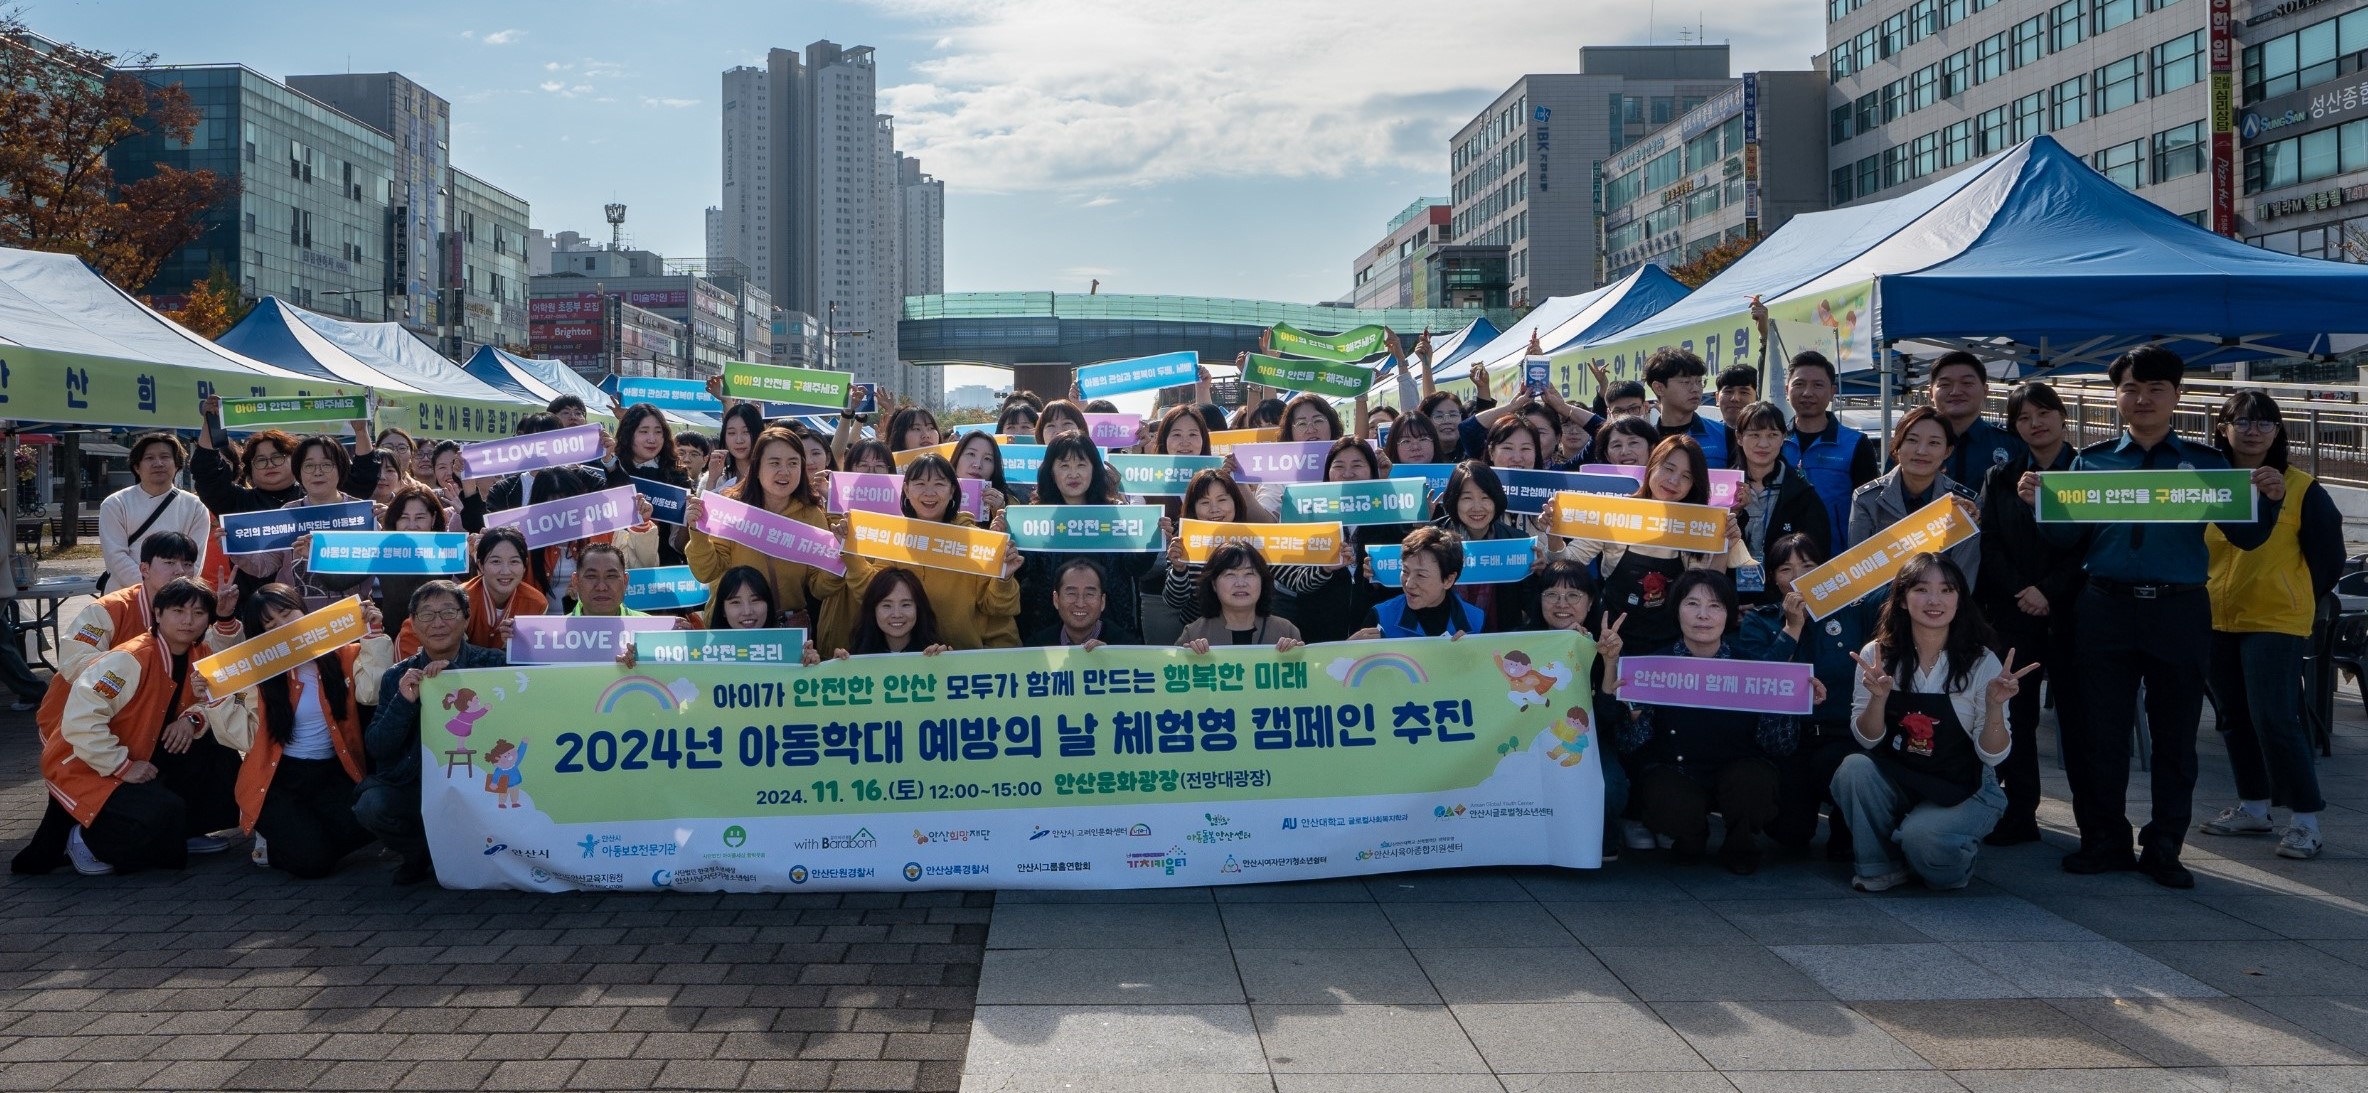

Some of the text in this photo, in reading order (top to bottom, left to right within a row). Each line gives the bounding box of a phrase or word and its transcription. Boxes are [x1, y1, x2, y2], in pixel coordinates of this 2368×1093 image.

[2216, 91, 2229, 131] 심리상담
[1537, 127, 1549, 192] IBK 기업은행
[2217, 157, 2230, 187] Pizza
[2218, 188, 2229, 211] Hut
[558, 302, 581, 312] 초등부
[584, 302, 600, 312] 모집
[554, 327, 582, 338] Brighton
[733, 374, 840, 396] 아이의 안전을 구해주세요
[1084, 376, 1107, 388] 아동의
[1108, 372, 1131, 385] 관심과
[1132, 367, 1156, 381] 행복이
[1257, 365, 1362, 388] 아이의 안전을 구해주세요
[235, 399, 355, 414] 아이의 안전을 구해주세요
[419, 402, 518, 437] 안산시육아종합지
[1097, 424, 1130, 438] 지켜요
[482, 435, 585, 465] I LOVE 아이
[1252, 453, 1319, 471] I LOVE
[843, 487, 895, 504] 안산아이
[1501, 485, 1519, 496] 리의
[2057, 488, 2233, 504] 아이의 안전을 구해주세요
[652, 495, 678, 509] 아동보호
[235, 516, 365, 539] 우리의 관심에서 시작되는 아동보호
[527, 501, 618, 536] LOVE 아이
[1022, 518, 1144, 537] 아이+안전=권리
[1561, 507, 1717, 537] 행복의 아이를 그리는 안산
[709, 508, 839, 559] 안산아이 함께 지켜요
[854, 525, 997, 562] 행복의 아이를 그리는 안산
[1189, 535, 1226, 549] 행복의
[1269, 536, 1304, 550] 그리는
[1307, 538, 1333, 551] 안산
[320, 546, 349, 559] 아동의
[351, 546, 380, 559] 관심과
[383, 547, 412, 559] 행복이
[1507, 554, 1527, 566] 세배
[1811, 514, 1956, 601] 행복의 아이를 그리는 안산
[626, 582, 645, 596] 심과
[648, 581, 675, 594] 행복이
[212, 613, 355, 683] 행복의 아이를 그리는 안산
[534, 631, 545, 649] I
[552, 630, 612, 650] LOVE
[654, 643, 783, 663] 아이+안전=권리
[713, 662, 1308, 709] 아이가 안전한 안산 모두가 함께 만드는 행복한 미래
[1634, 670, 1794, 696] 안산아이 함께 지켜요
[555, 699, 1476, 773] 2024년 아동학대 예방의 날 체험형 캠페인 추진
[756, 790, 807, 805] 2024.
[811, 780, 844, 803] 11.
[929, 781, 1042, 799] 12:00~15:00
[1469, 808, 1554, 818] 안산시글로벌청소년센터
[1282, 818, 1297, 829] AU
[1301, 817, 1345, 828] 안산대학교
[929, 829, 991, 843] 안산희망재단
[1052, 829, 1074, 838] 안산시
[1077, 827, 1127, 838] 고려인문화센터
[602, 843, 676, 858] 아동보호전문기관
[794, 838, 818, 849] with
[1374, 843, 1463, 859] 안산시육아종합지원센터
[926, 865, 989, 877] 안산상록경찰서
[1017, 861, 1091, 872] 안산시그룹홈연합회
[1242, 857, 1327, 869] 안산시여자단기청소년쉼터
[811, 867, 875, 879] 안산단원경찰서
